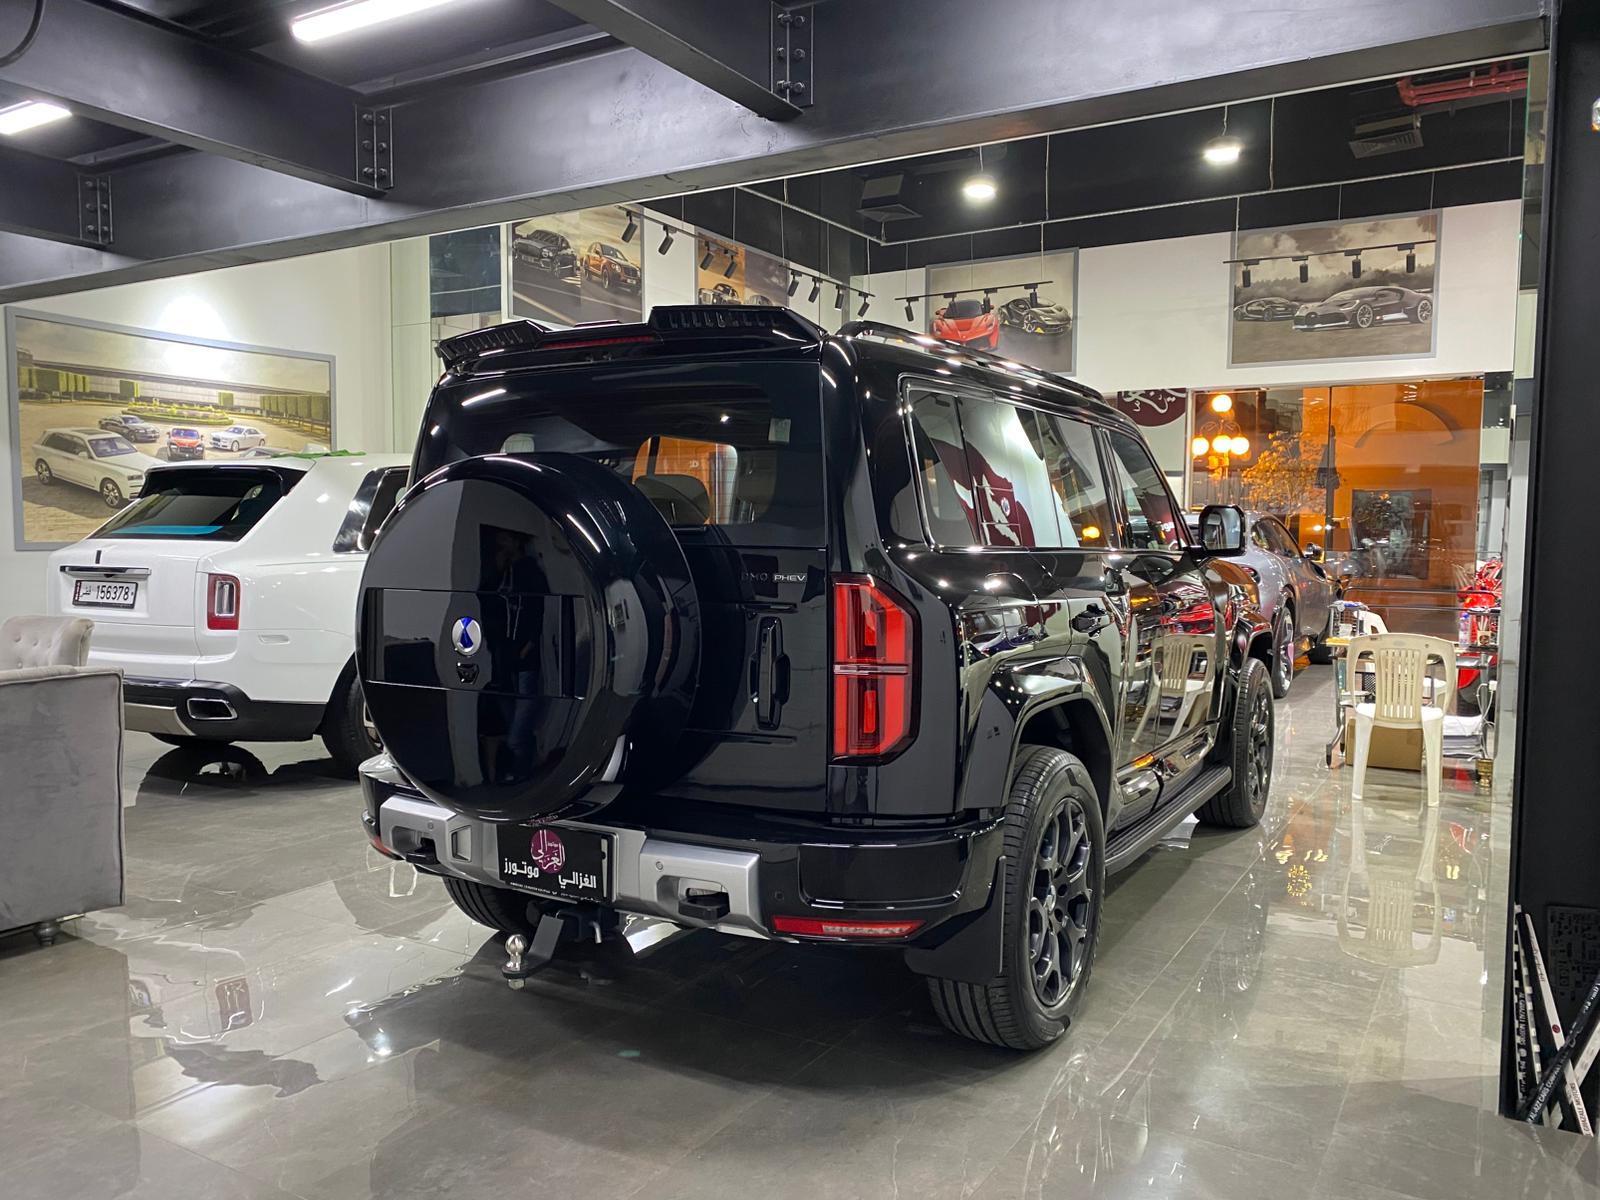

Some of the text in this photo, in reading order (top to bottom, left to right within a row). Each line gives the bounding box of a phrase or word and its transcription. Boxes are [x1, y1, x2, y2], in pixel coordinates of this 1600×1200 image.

[774, 574, 806, 582] PHEV
[96, 584, 130, 601] 156378
[504, 857, 540, 879] موتورز
[558, 871, 597, 889] الغزالي
